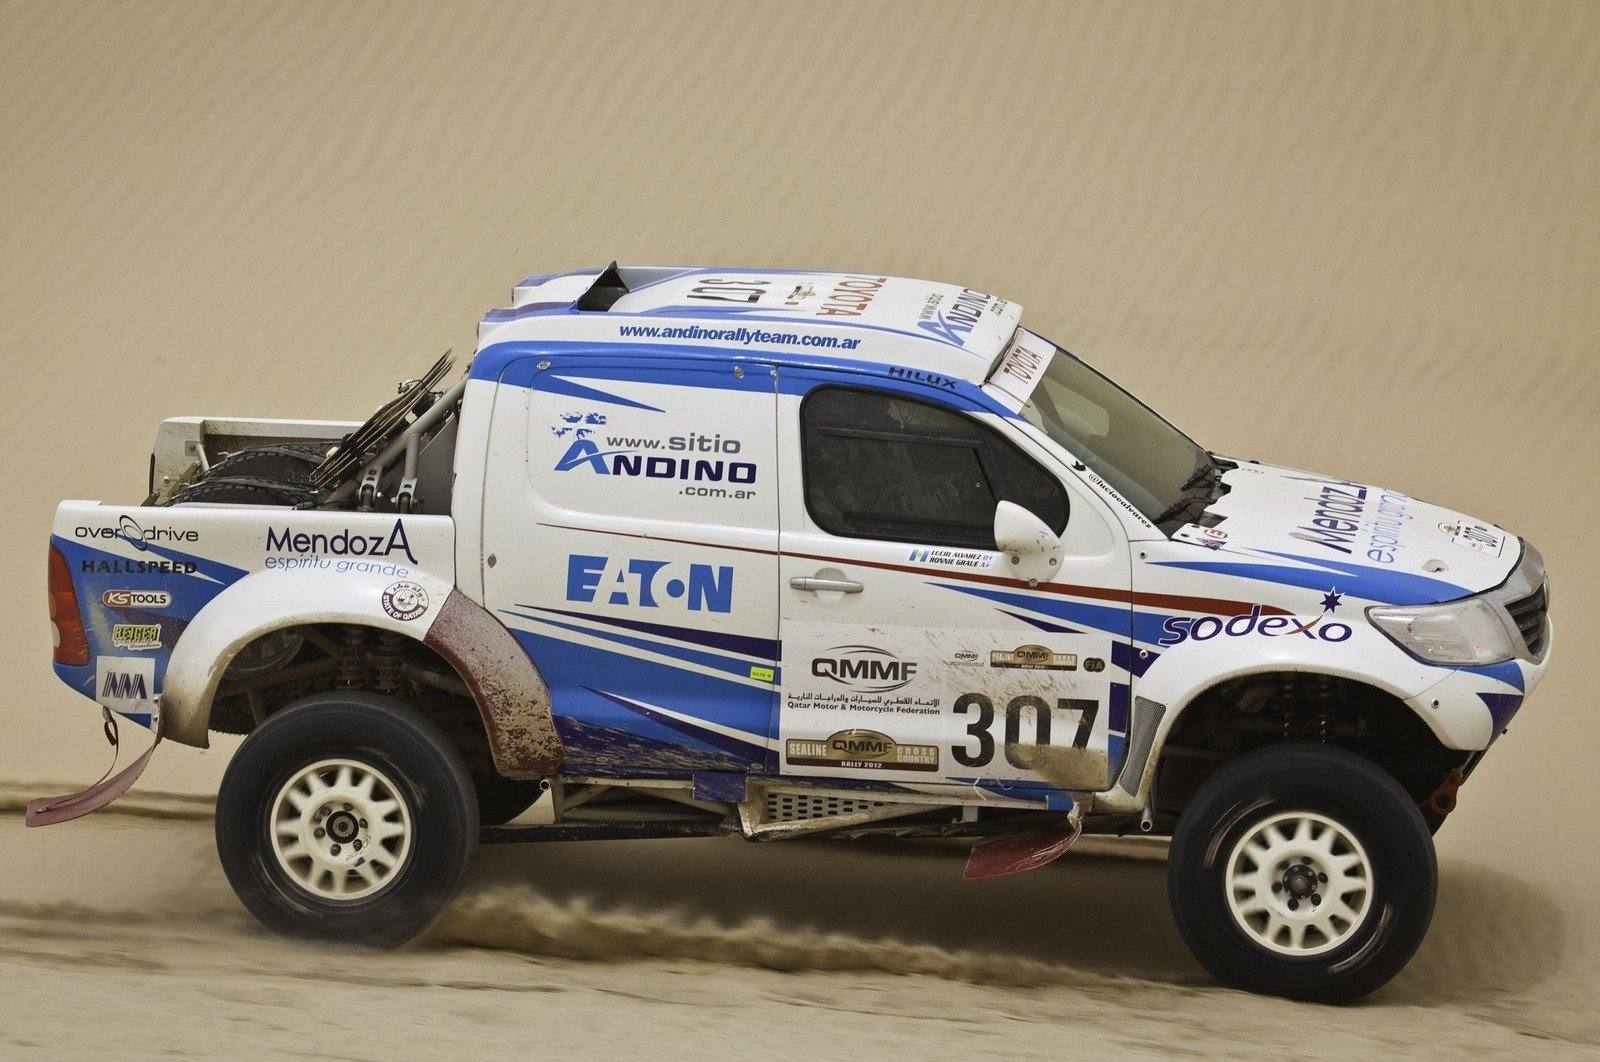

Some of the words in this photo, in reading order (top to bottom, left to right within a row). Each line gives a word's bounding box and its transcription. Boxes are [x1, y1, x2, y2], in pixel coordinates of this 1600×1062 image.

[618, 323, 861, 351] www.andinorallyteam.com.ar
[888, 365, 959, 391] HILUX
[553, 439, 758, 484] ANDINO
[678, 486, 757, 501] .com.ar
[265, 518, 418, 566] MendozA
[81, 560, 198, 575] HALLSPEED
[336, 559, 410, 579] grande
[566, 554, 734, 613] EATON
[130, 594, 166, 604] TOOLS
[1157, 604, 1353, 647] sodexo
[811, 657, 918, 684] QMMF
[787, 701, 811, 709] Qatar
[813, 702, 839, 711] Motor
[840, 703, 847, 711] &
[849, 704, 894, 714] Motorcycle
[896, 706, 941, 715] Federation
[950, 692, 1100, 769] 307
[789, 743, 828, 757] SEALINE
[832, 739, 895, 754] QMMF
[897, 746, 935, 756] CROSS
[841, 760, 863, 768] RALLY
[863, 761, 883, 769] 2012
